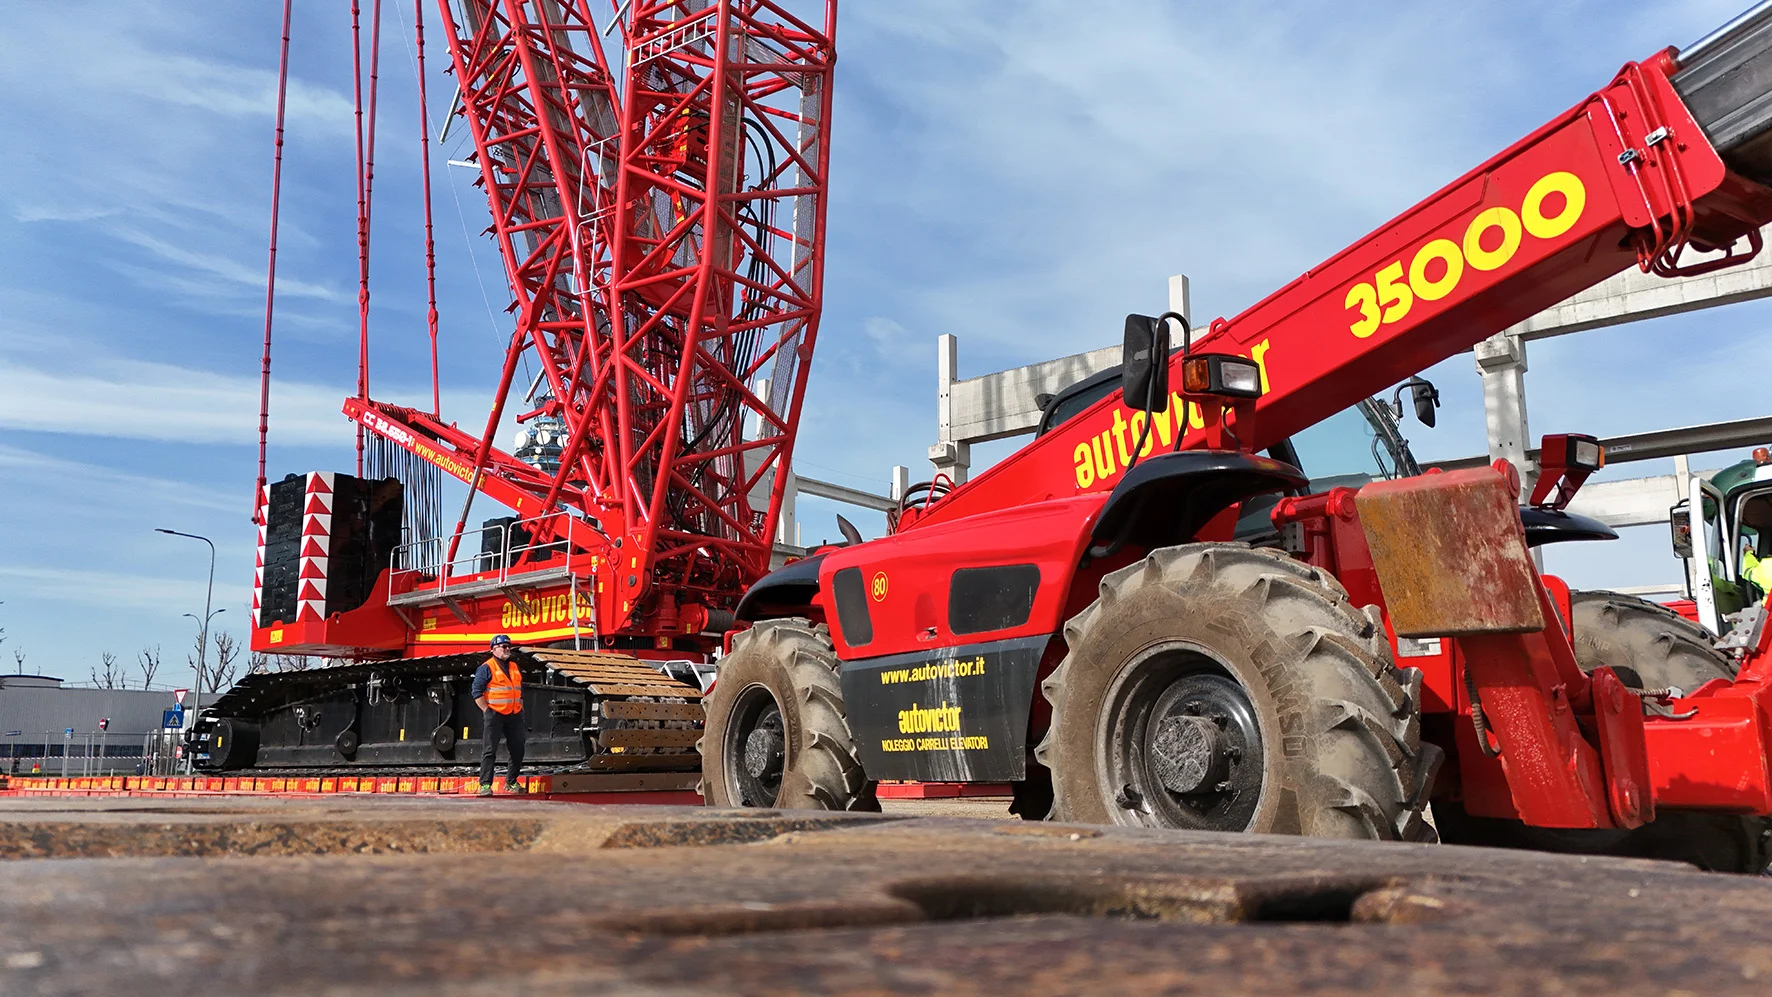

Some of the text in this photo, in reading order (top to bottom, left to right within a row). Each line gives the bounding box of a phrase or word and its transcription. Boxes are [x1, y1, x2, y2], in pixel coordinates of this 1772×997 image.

[1345, 171, 1586, 338] 35000
[363, 411, 376, 426] CC
[874, 577, 885, 596] 80
[881, 657, 985, 685] www.autovictor.it
[899, 701, 962, 734] autovictor
[882, 736, 989, 752] NOLEGGIO CARRELLI ELEVATORI
